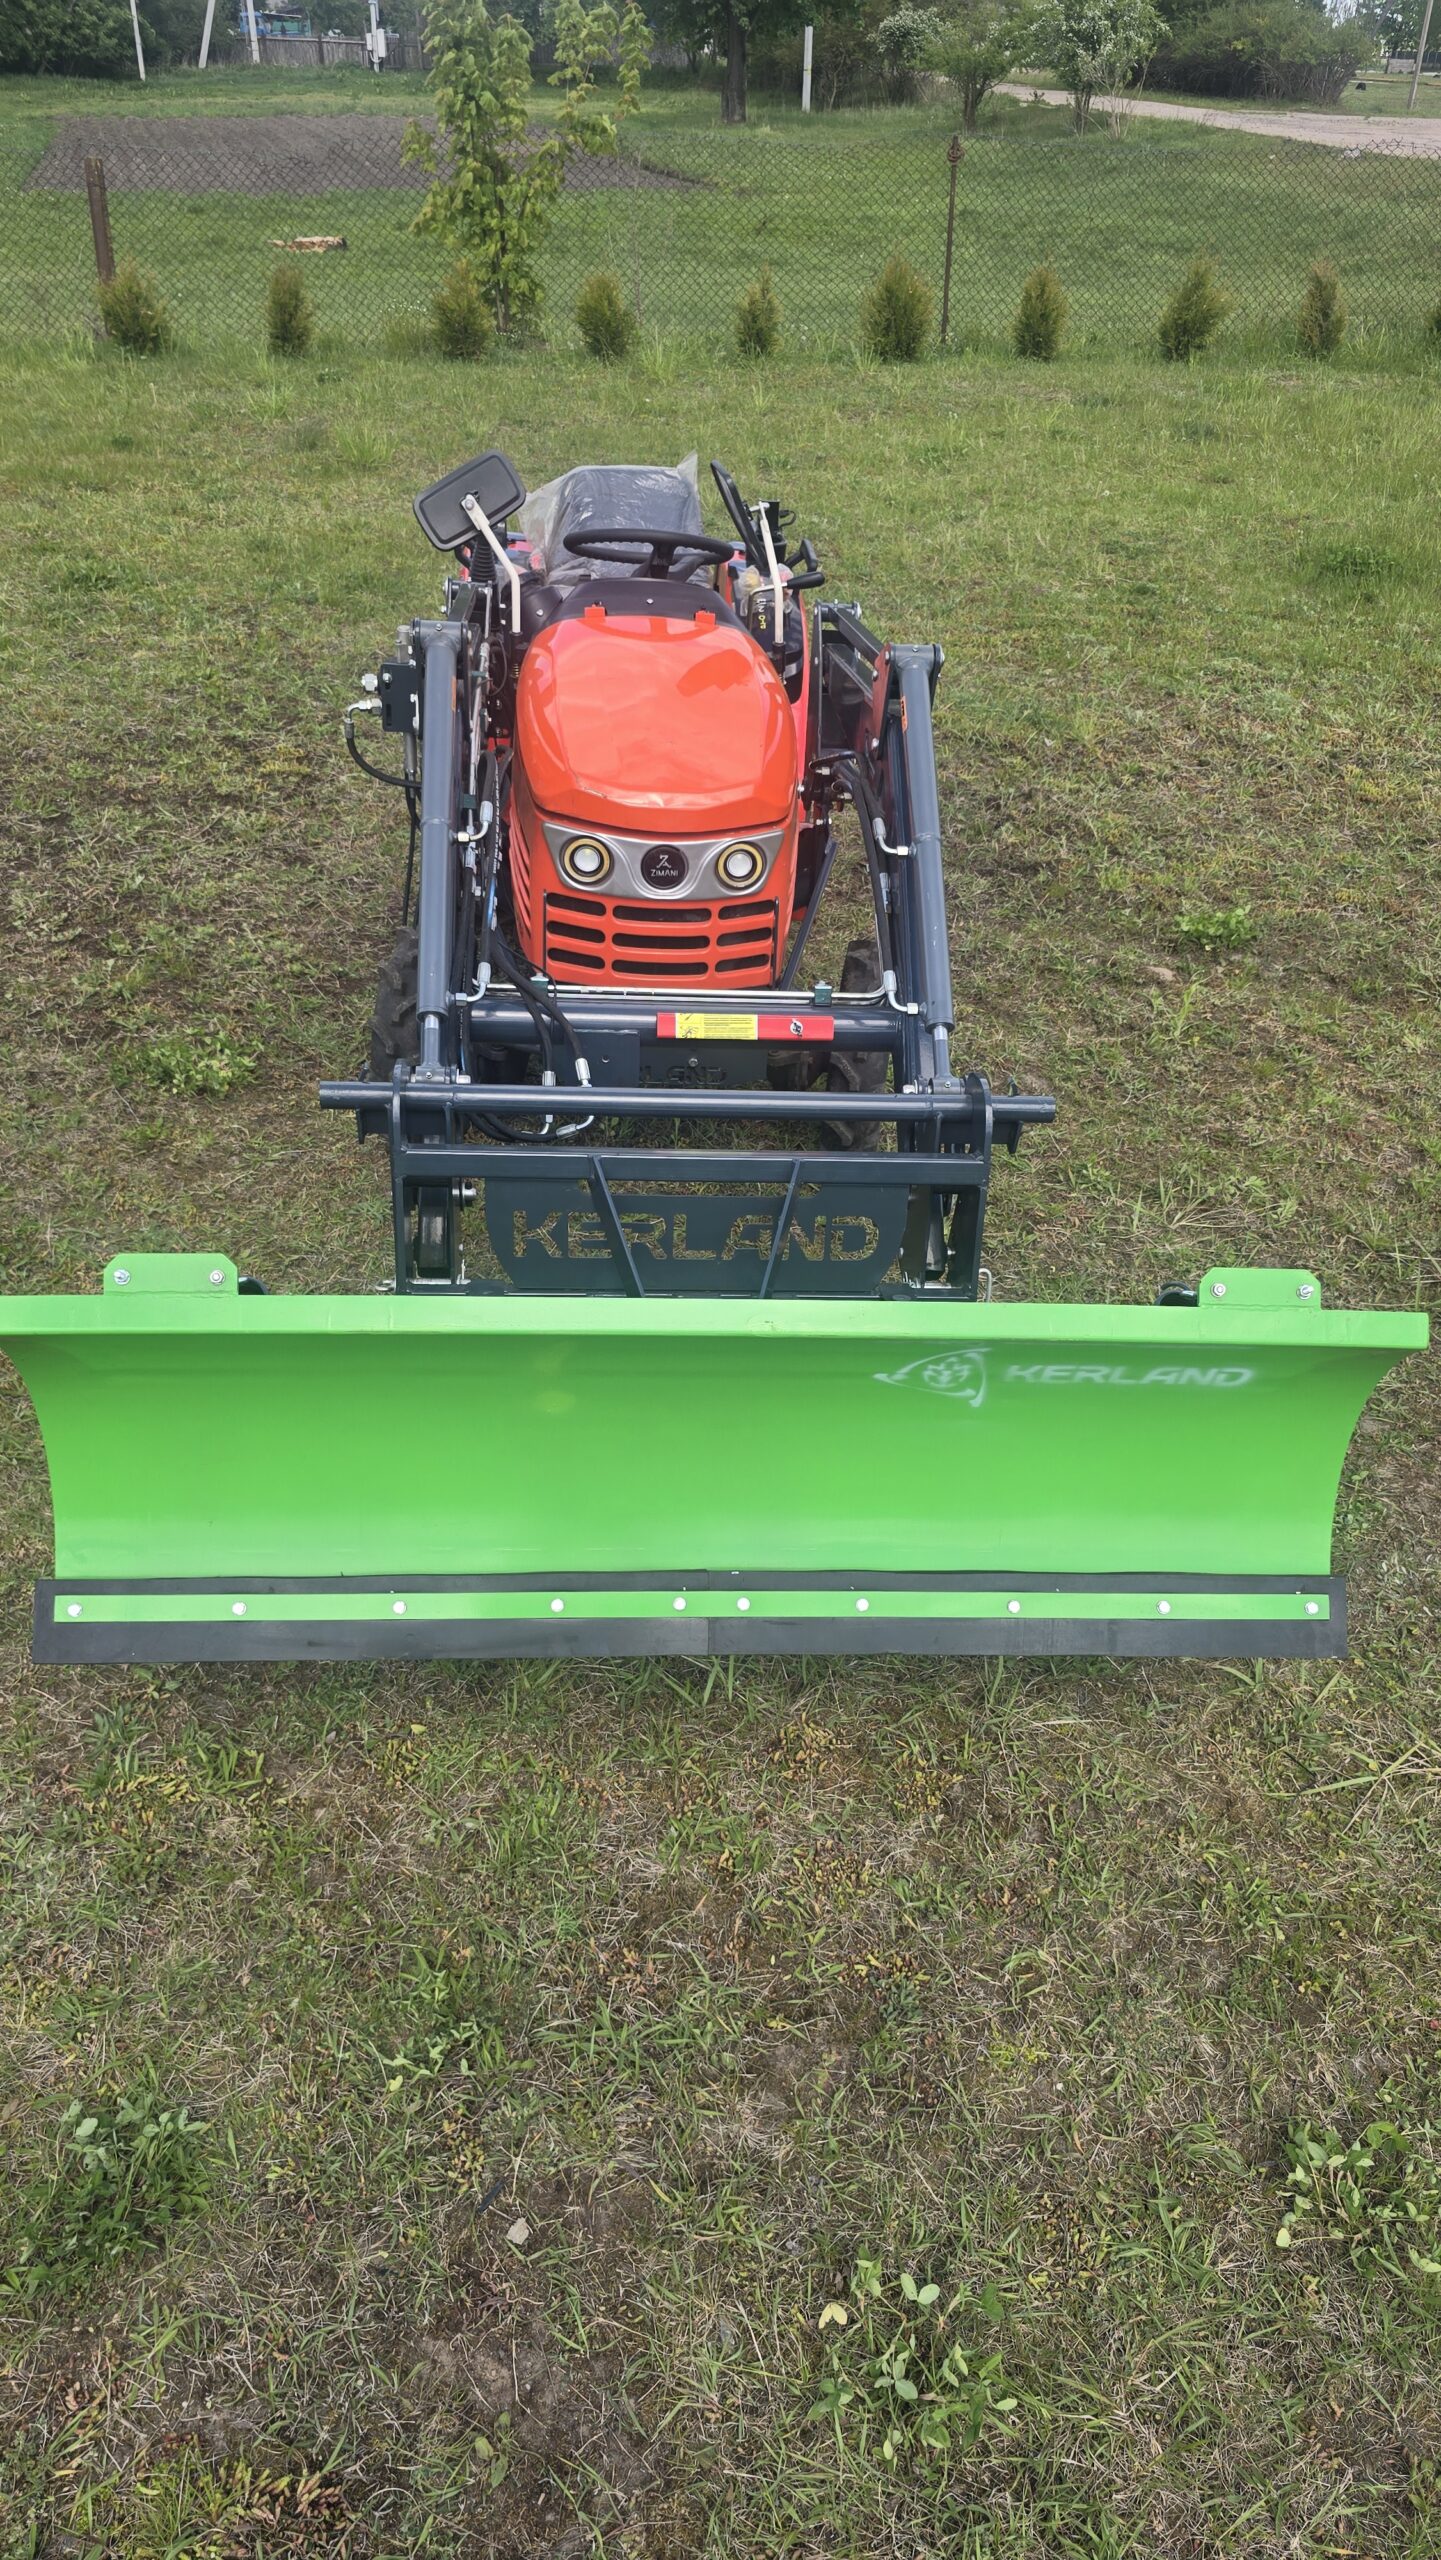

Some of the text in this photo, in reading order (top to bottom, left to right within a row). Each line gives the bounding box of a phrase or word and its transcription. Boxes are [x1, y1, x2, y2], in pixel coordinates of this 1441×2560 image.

[650, 869, 679, 877] ZIMANI
[512, 1210, 880, 1261] KERLAND
[1004, 1364, 1256, 1387] KERLAND
